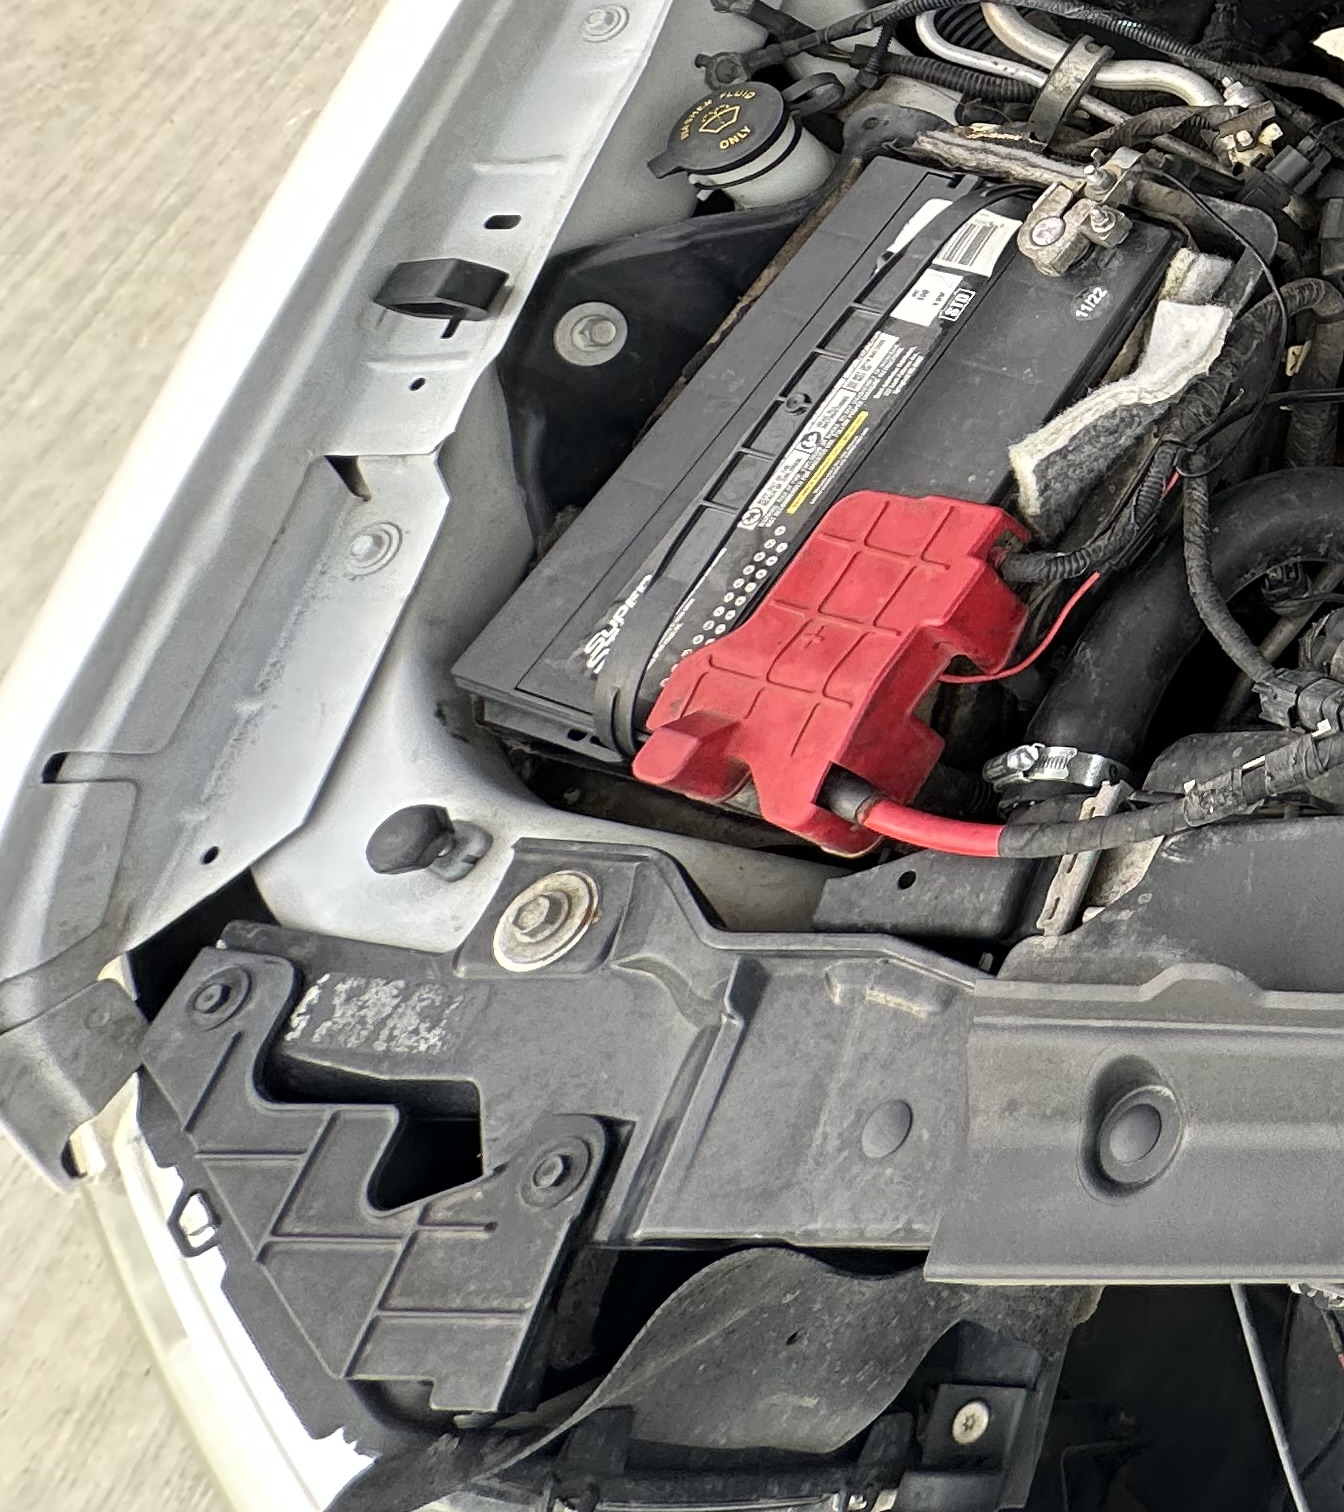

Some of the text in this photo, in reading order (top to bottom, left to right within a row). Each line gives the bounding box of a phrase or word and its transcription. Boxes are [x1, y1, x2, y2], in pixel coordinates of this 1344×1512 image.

[680, 90, 756, 141] WASHER FLUID
[719, 125, 751, 150] ONLY
[1075, 286, 1108, 317] 11/22
